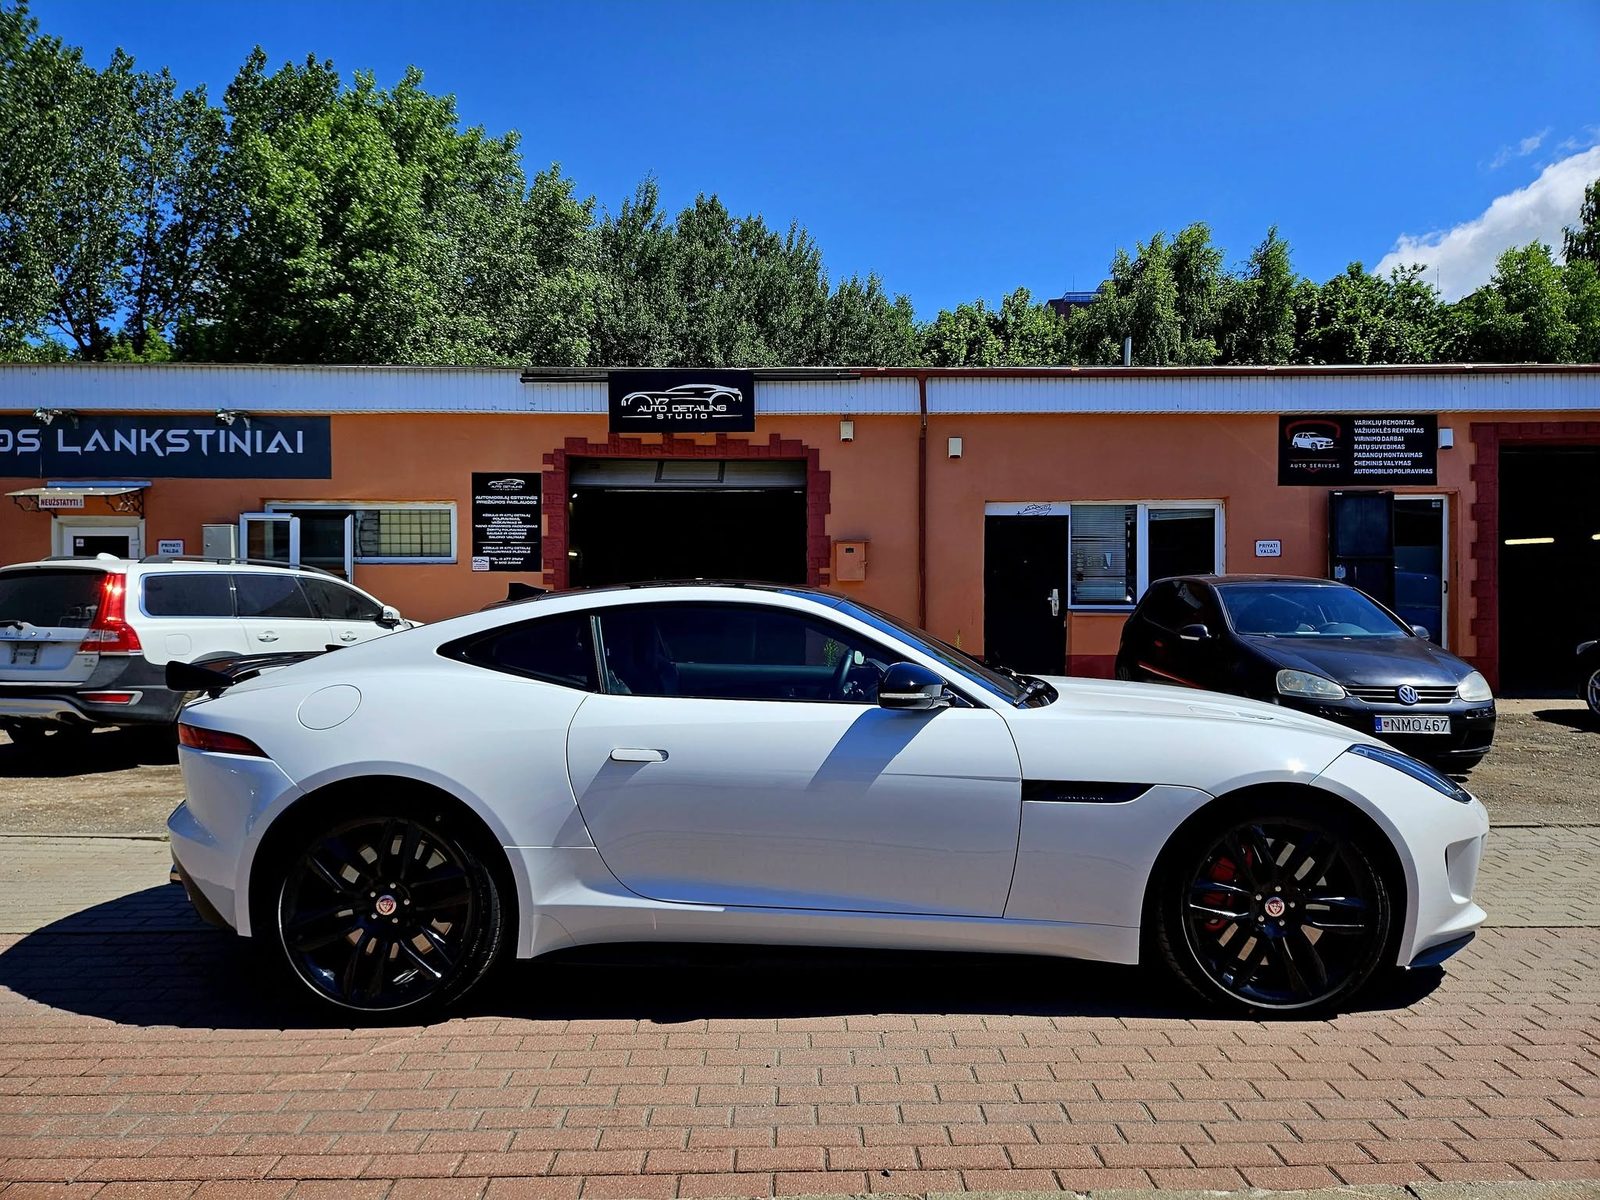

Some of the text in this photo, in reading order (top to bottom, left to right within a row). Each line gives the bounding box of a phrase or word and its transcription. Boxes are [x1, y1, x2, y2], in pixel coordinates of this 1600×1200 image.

[672, 404, 726, 412] DETAILING
[57, 428, 304, 457] LANKSTINIAI
[41, 498, 78, 506] NEUŽSTATYTI
